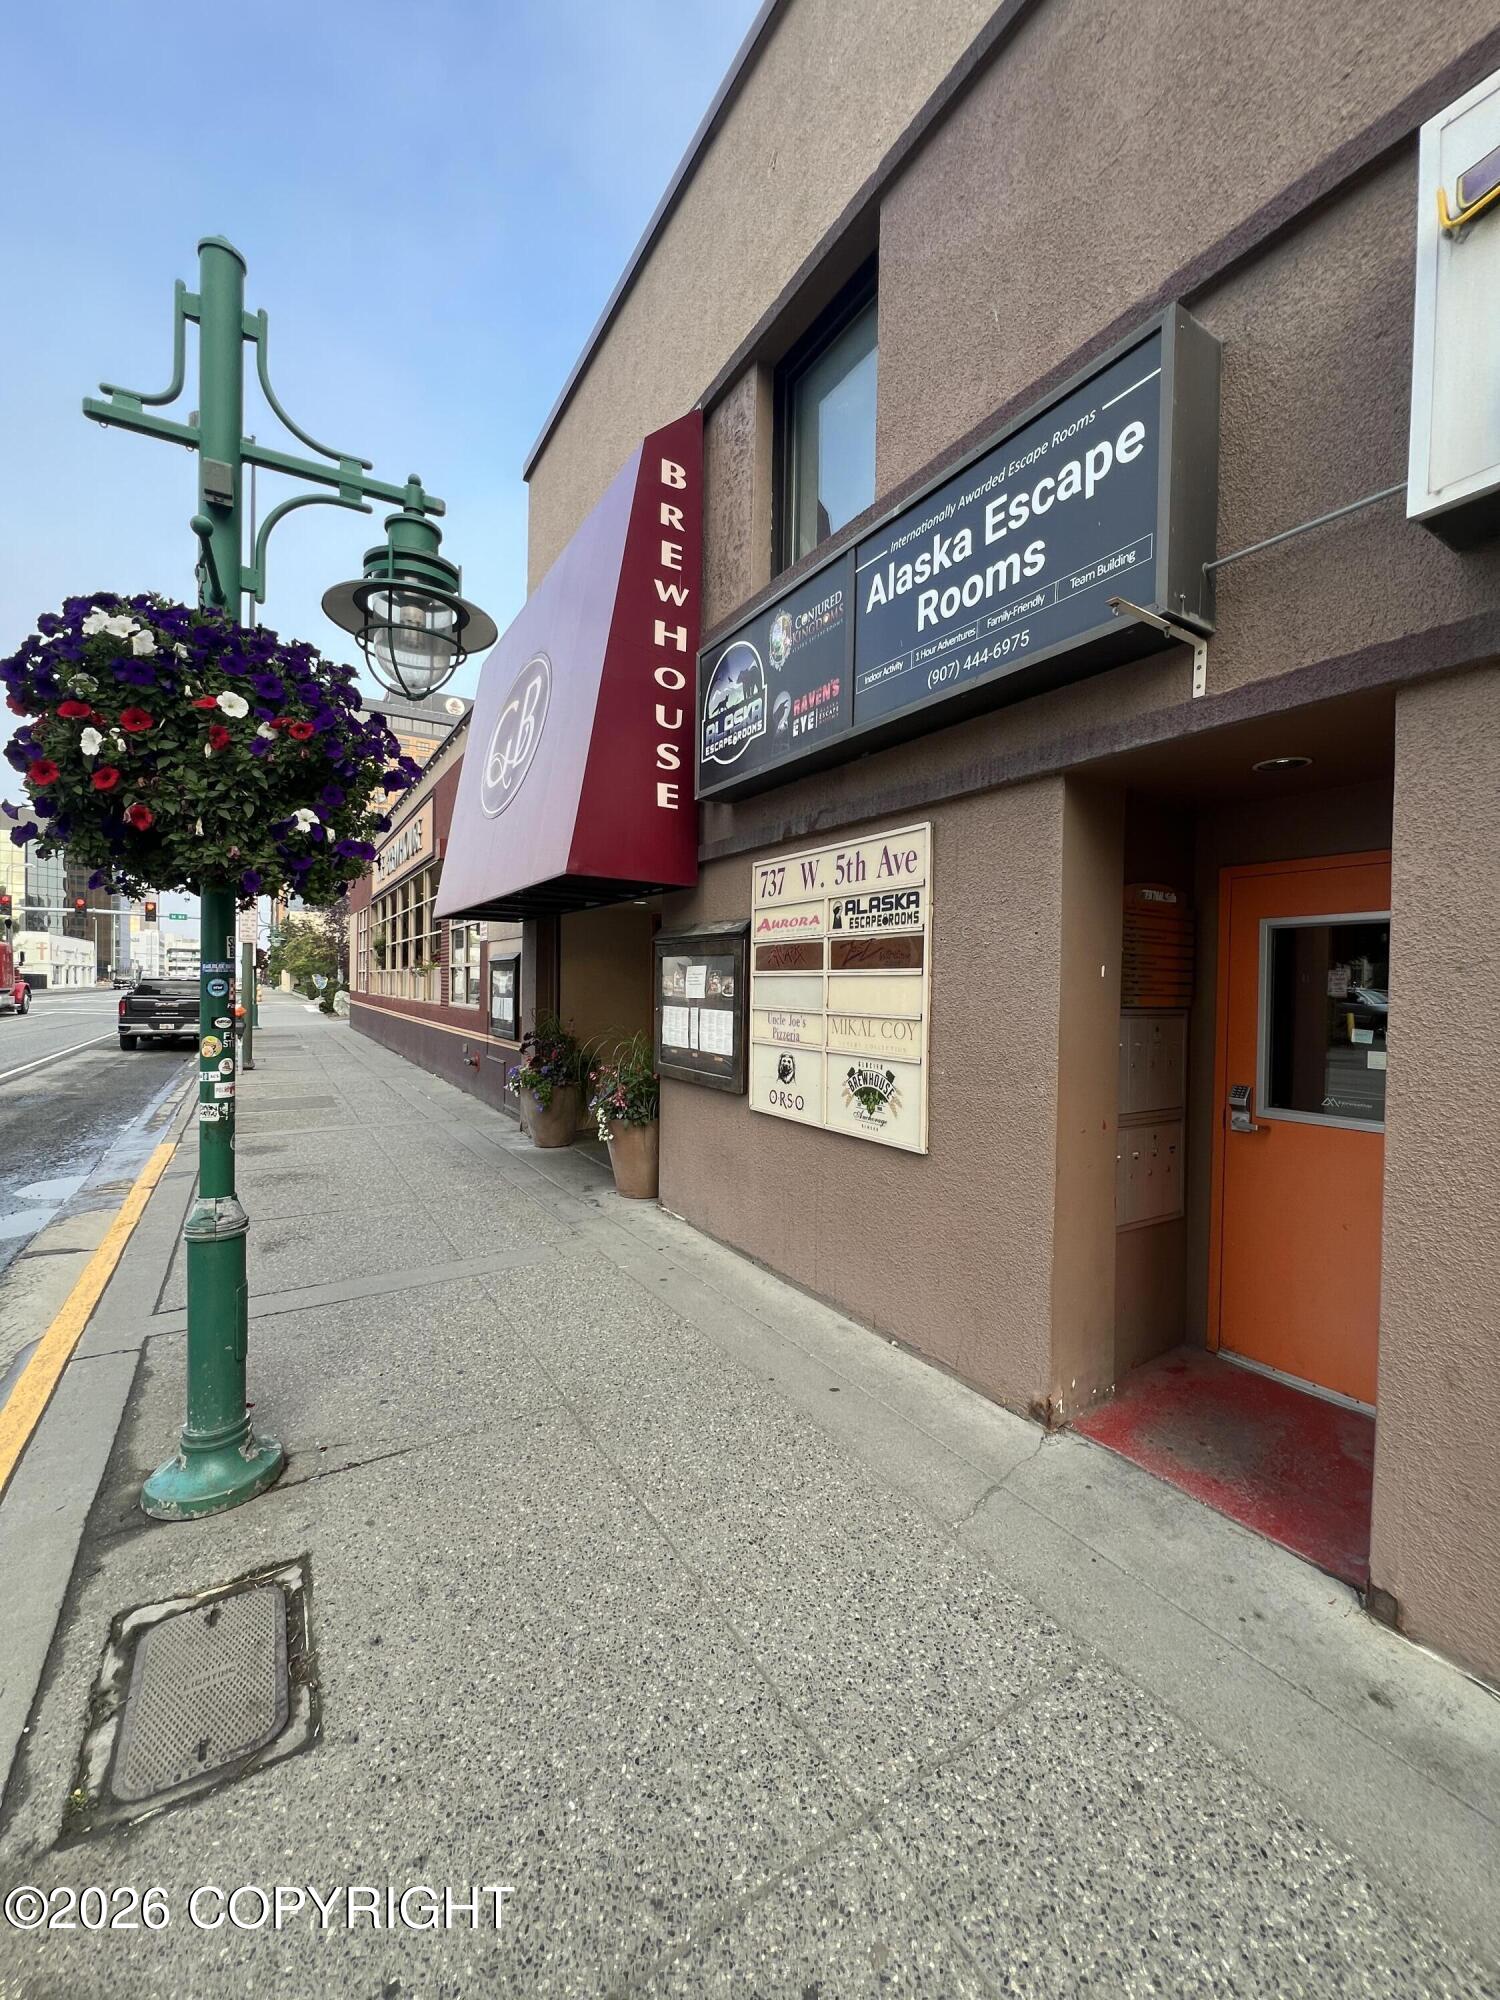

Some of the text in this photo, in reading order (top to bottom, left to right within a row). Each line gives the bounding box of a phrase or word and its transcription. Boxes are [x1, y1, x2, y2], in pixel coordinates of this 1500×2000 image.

[890, 409, 1097, 553] Internationally Awarded Escape Rooms
[865, 420, 1146, 614] Alaska Escape
[917, 539, 1047, 633] Rooms
[1070, 549, 1136, 588] Team Building
[791, 603, 844, 646] KINGDOMS
[794, 590, 843, 630] CONJURED
[986, 593, 1046, 628] Family-Friendly
[654, 458, 690, 810] BREWHOUSE
[915, 627, 976, 662] 1 Hour Adventures
[864, 661, 904, 685] Indoor Activity
[927, 629, 1031, 690] (907) 444-6975
[705, 697, 763, 746] ALASKA
[705, 720, 763, 757] ESCAPE ROOMS
[792, 710, 815, 737] EYE
[760, 845, 918, 898] 737 W. 5th Ave
[844, 891, 920, 917] ALASKA
[849, 911, 920, 930] ESCAPE ROOMS
[767, 1012, 807, 1029] Uncle Joe's
[772, 1027, 801, 1043] Pizzeria
[831, 1018, 918, 1041] MIKAL COY
[769, 1089, 805, 1111] ORSO
[847, 1072, 895, 1100] BREWHOUSE
